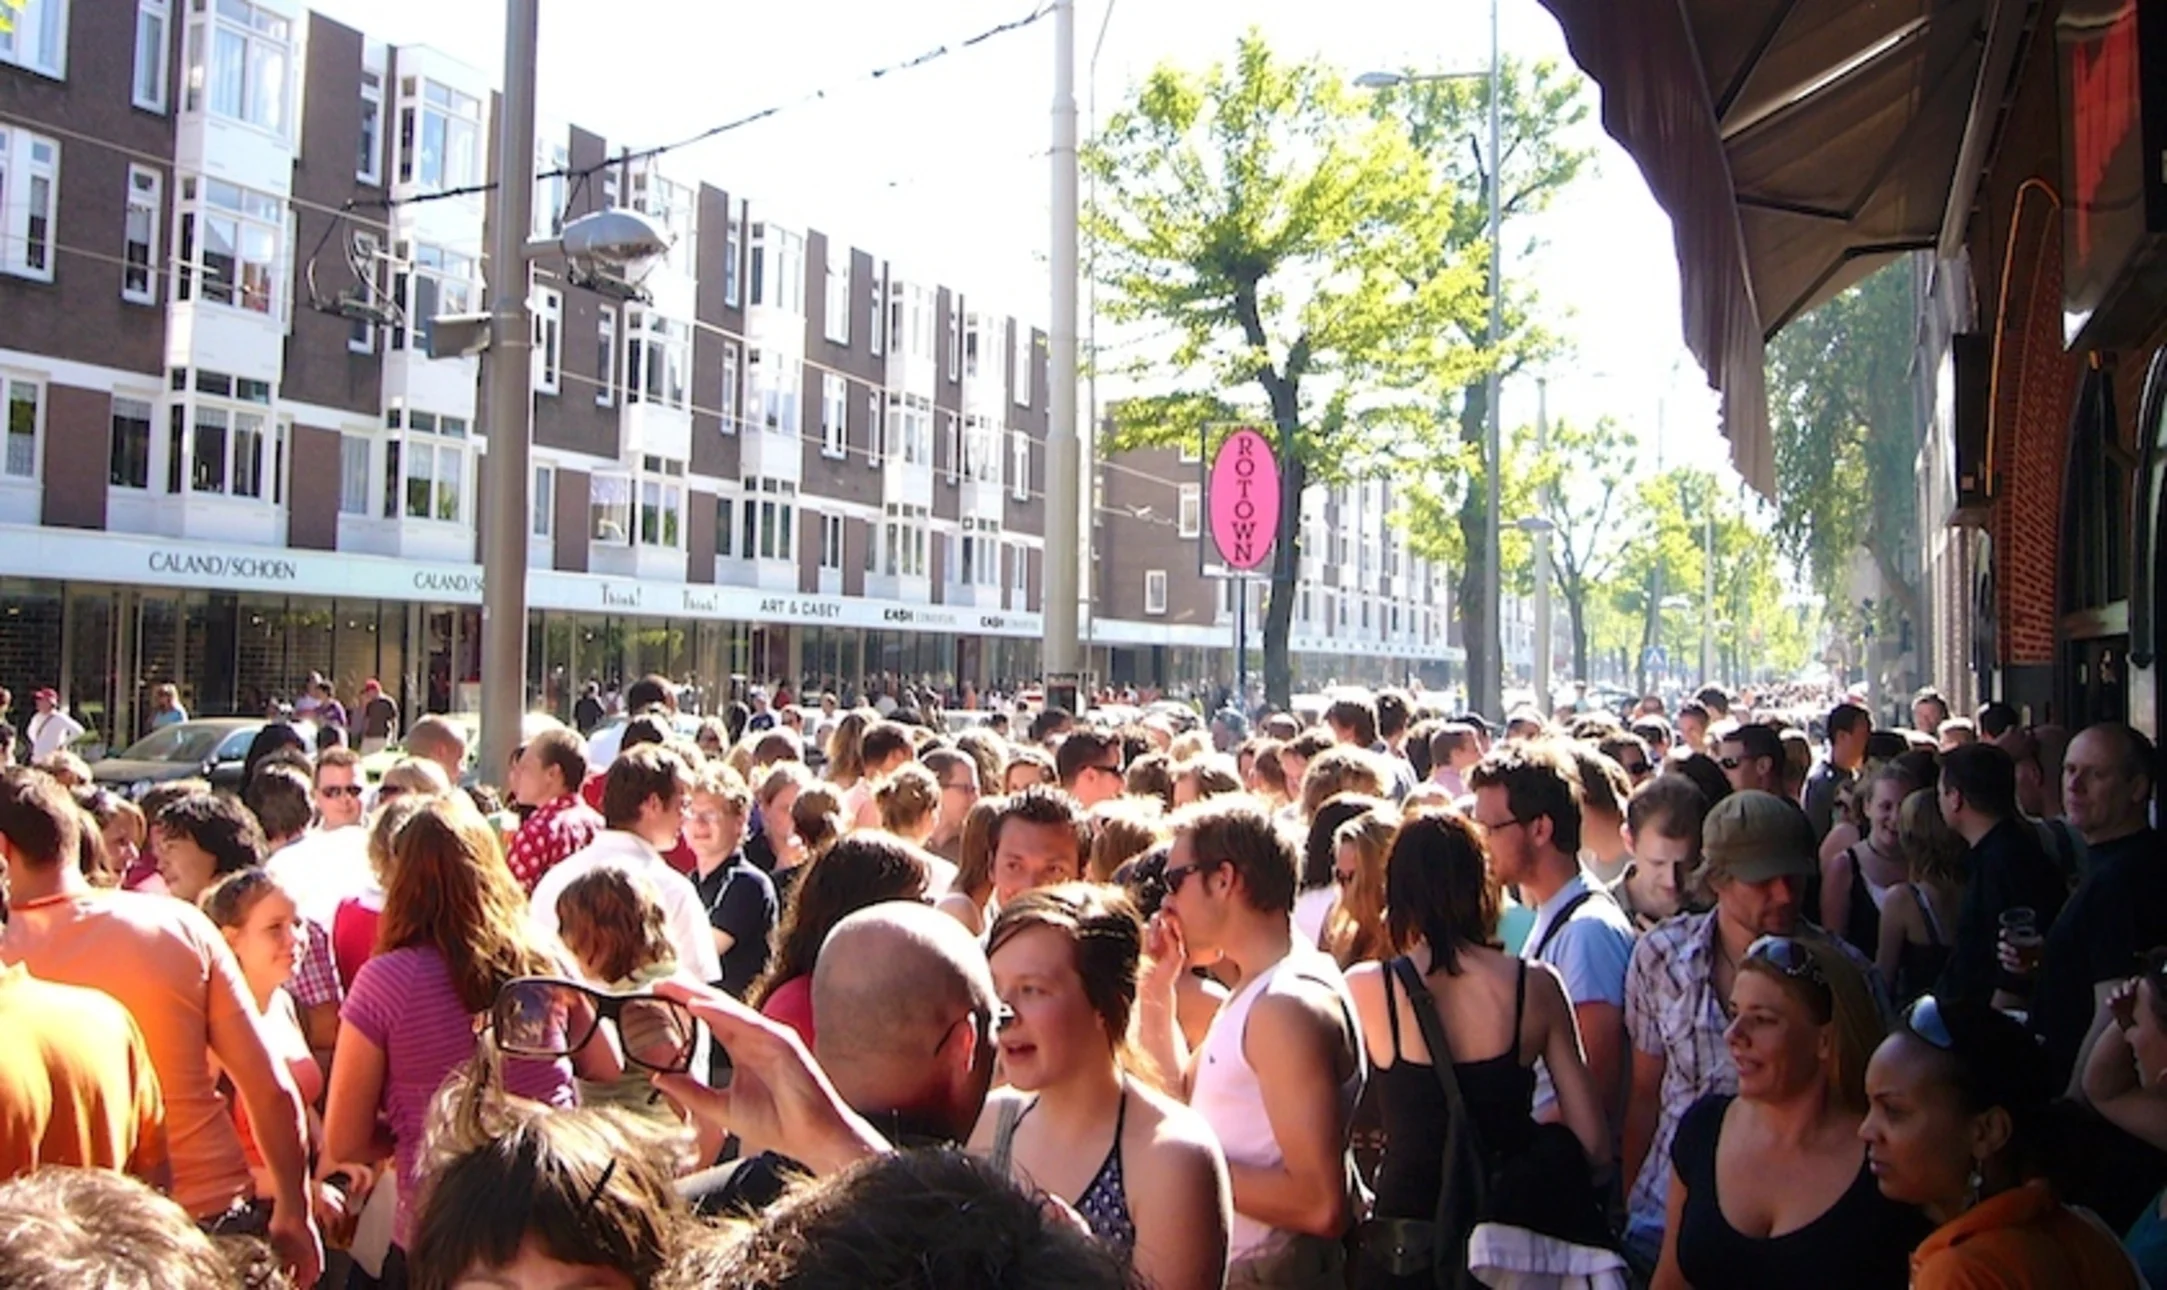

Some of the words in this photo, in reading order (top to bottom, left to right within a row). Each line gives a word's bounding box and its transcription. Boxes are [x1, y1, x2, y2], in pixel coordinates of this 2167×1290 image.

[1231, 436, 1256, 562] ROTOWN
[149, 550, 297, 580] CALAND/SCHOEN
[413, 570, 484, 594] CALAND/S
[760, 599, 783, 614] ART
[789, 602, 797, 615] &
[803, 602, 841, 618] CASEY
